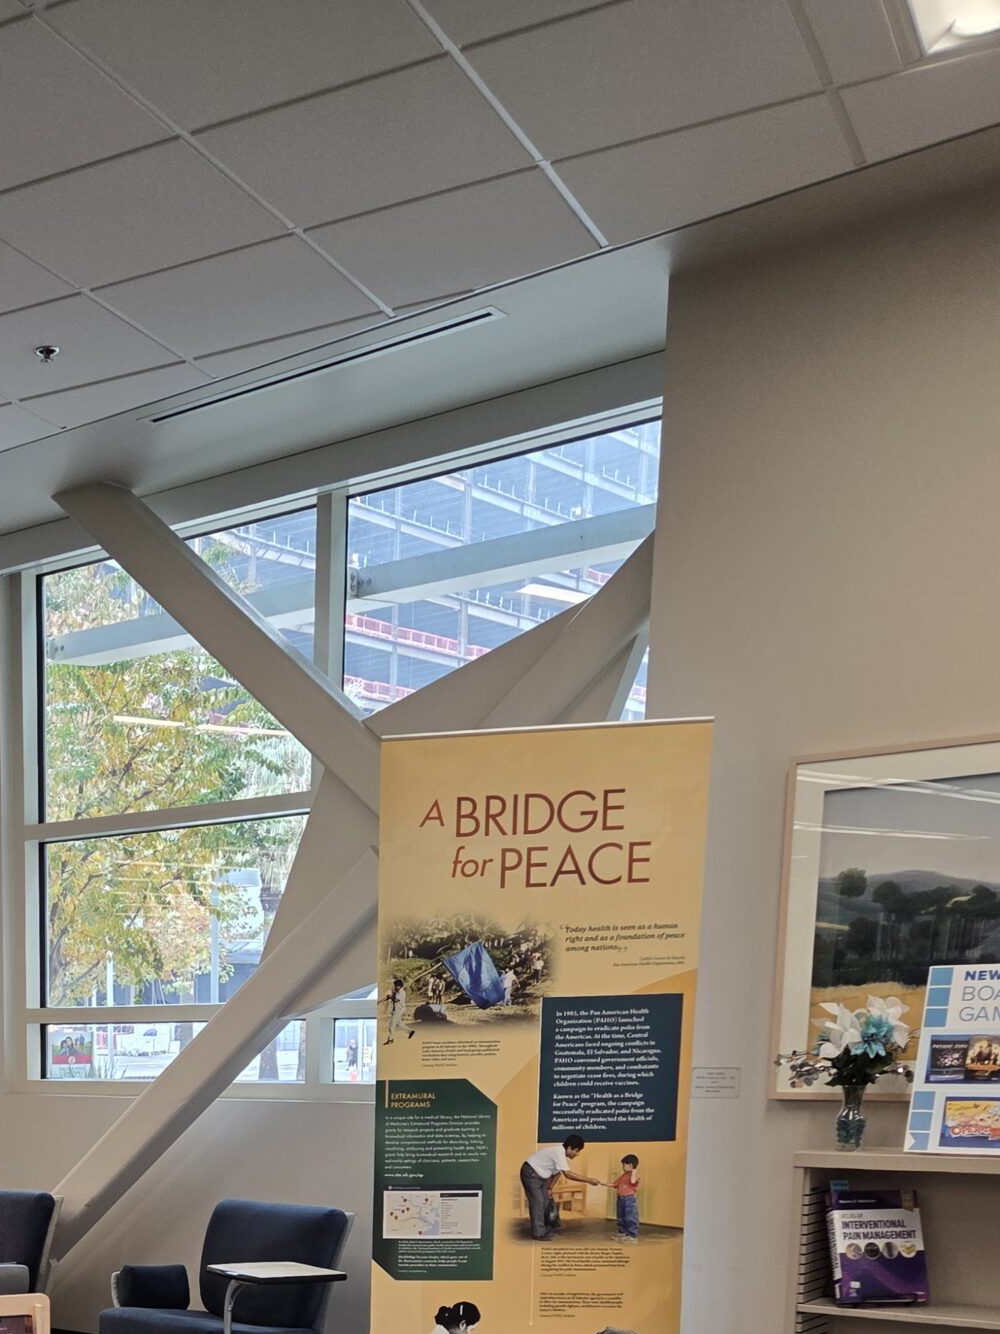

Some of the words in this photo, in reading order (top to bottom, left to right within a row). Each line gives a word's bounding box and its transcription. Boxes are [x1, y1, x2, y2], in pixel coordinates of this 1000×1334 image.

[419, 799, 445, 828] A
[456, 788, 625, 837] BRIDGE
[451, 846, 493, 878] for
[500, 841, 651, 889] PEACE
[615, 933, 654, 942] foundation
[657, 932, 665, 940] of
[964, 970, 1000, 981] NEW
[842, 1220, 906, 1229] INTERVENTIONAL
[843, 1231, 861, 1240] PAIN
[863, 1230, 916, 1240] MANAGEMENT
